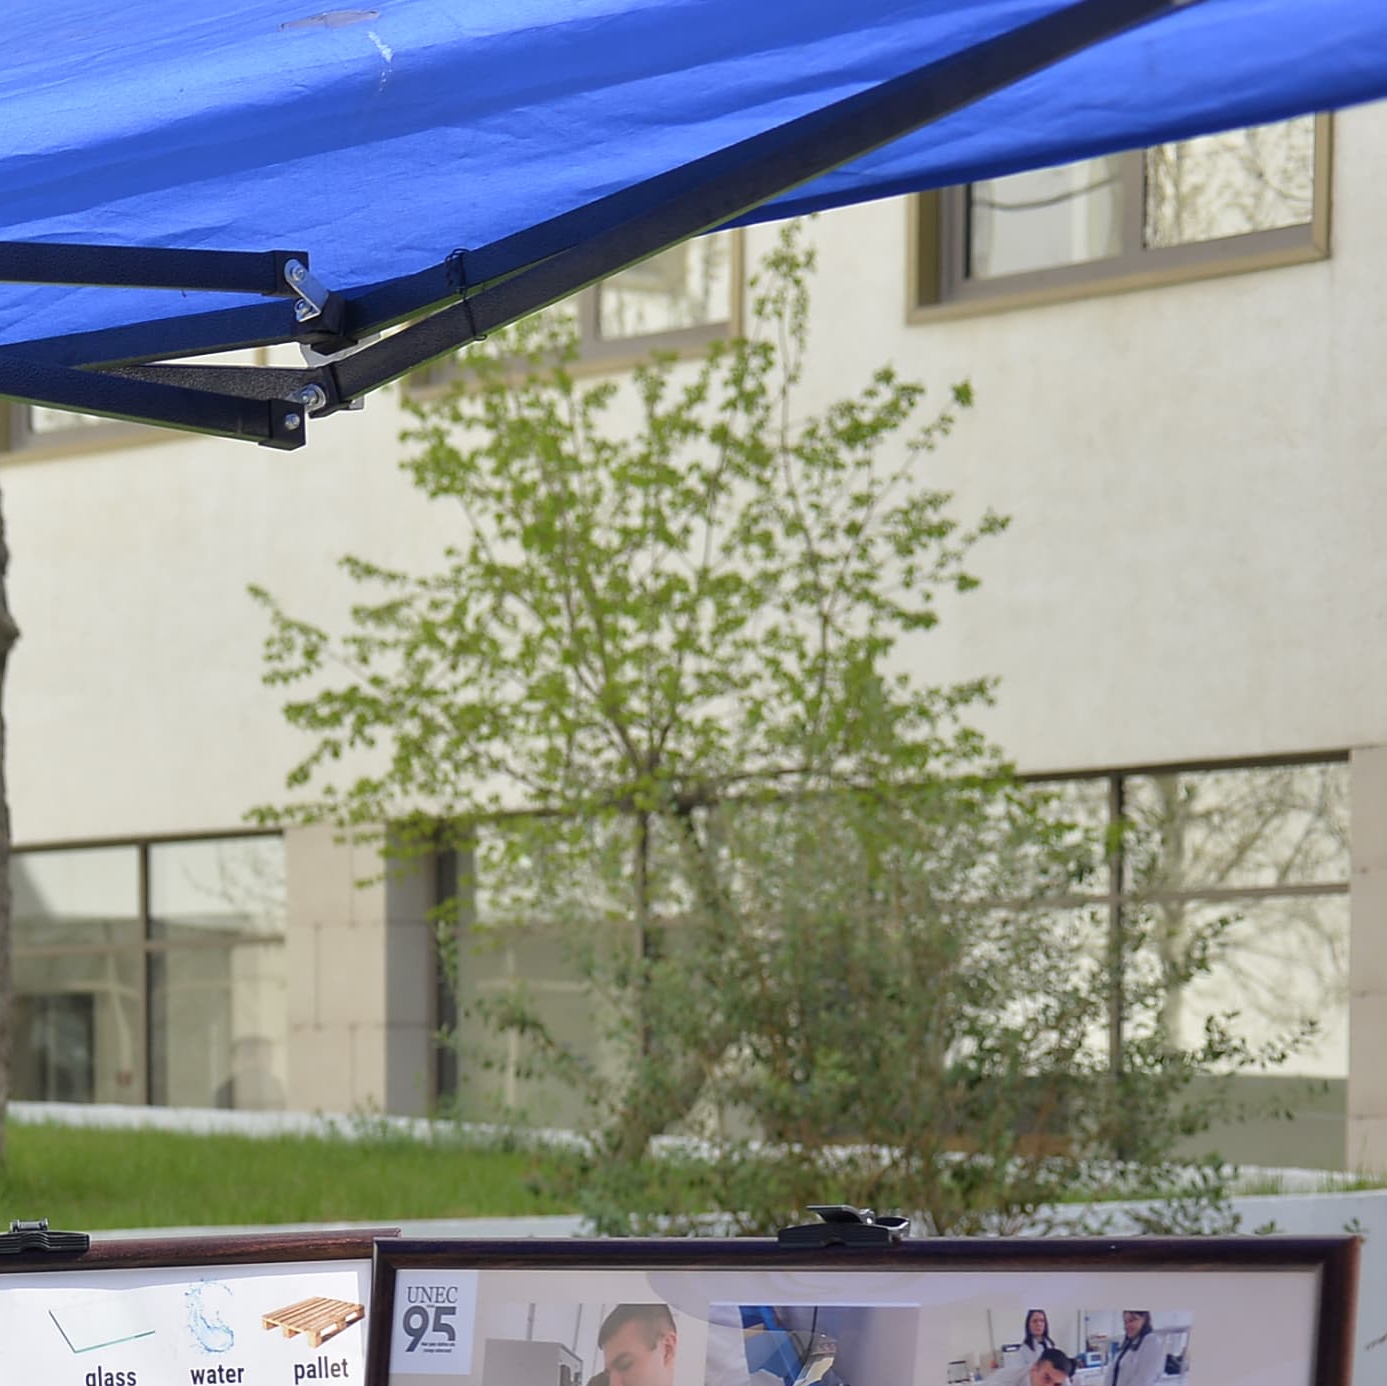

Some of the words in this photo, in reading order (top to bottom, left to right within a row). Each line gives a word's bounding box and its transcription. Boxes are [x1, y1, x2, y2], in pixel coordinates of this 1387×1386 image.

[407, 1286, 458, 1303] UNEC
[403, 1305, 456, 1352] 95
[190, 1364, 245, 1385] water
[293, 1356, 349, 1385] pallet
